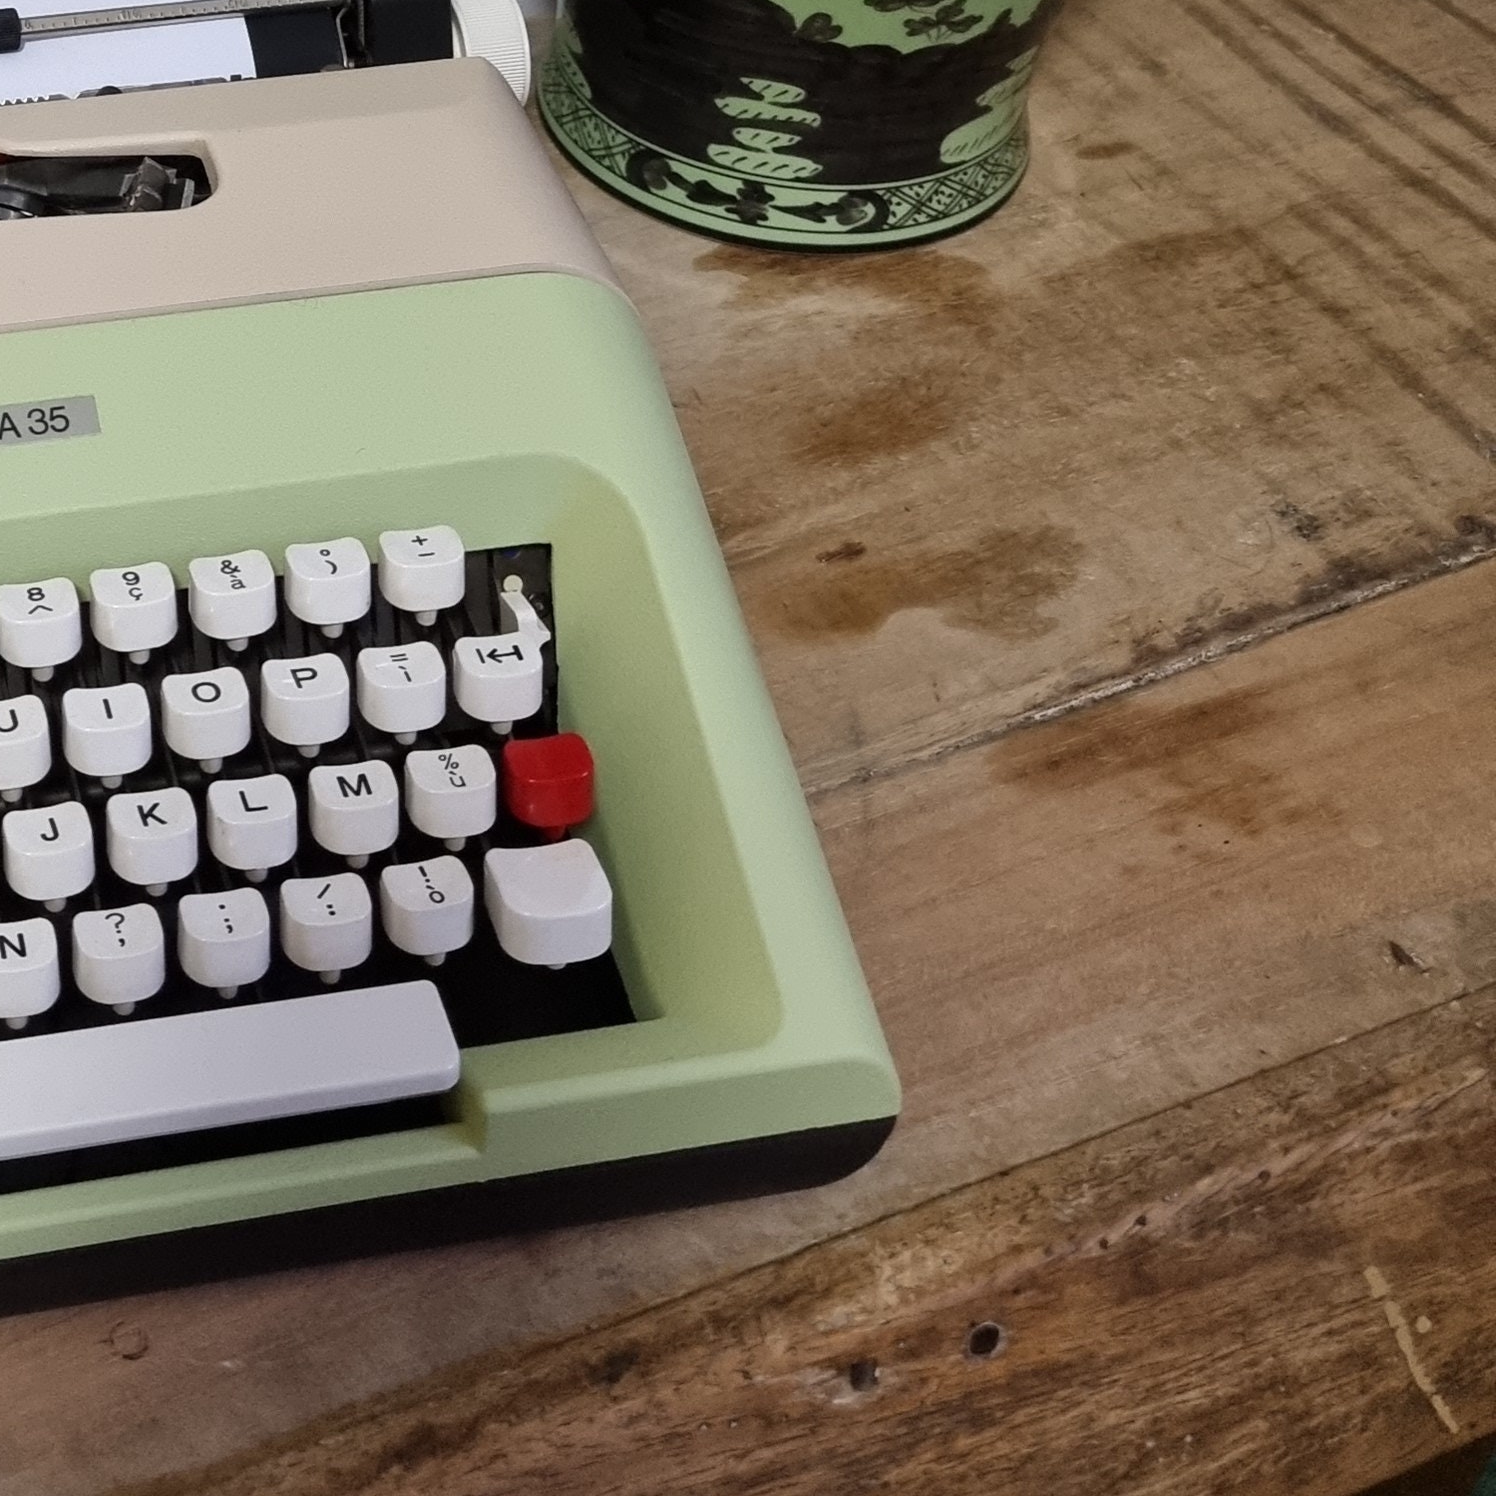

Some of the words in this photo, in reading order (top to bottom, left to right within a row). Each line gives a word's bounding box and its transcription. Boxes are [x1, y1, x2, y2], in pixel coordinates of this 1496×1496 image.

[26, 405, 71, 436] 35
[220, 559, 241, 575] &
[121, 571, 140, 586] 9
[26, 587, 46, 602] 8
[128, 587, 143, 601] ç
[290, 667, 318, 689] P
[191, 681, 222, 703] O
[438, 753, 460, 770] %
[336, 773, 373, 798] M
[238, 790, 269, 813] L
[137, 802, 168, 827] K
[40, 817, 60, 842] J
[104, 912, 125, 934] ?
